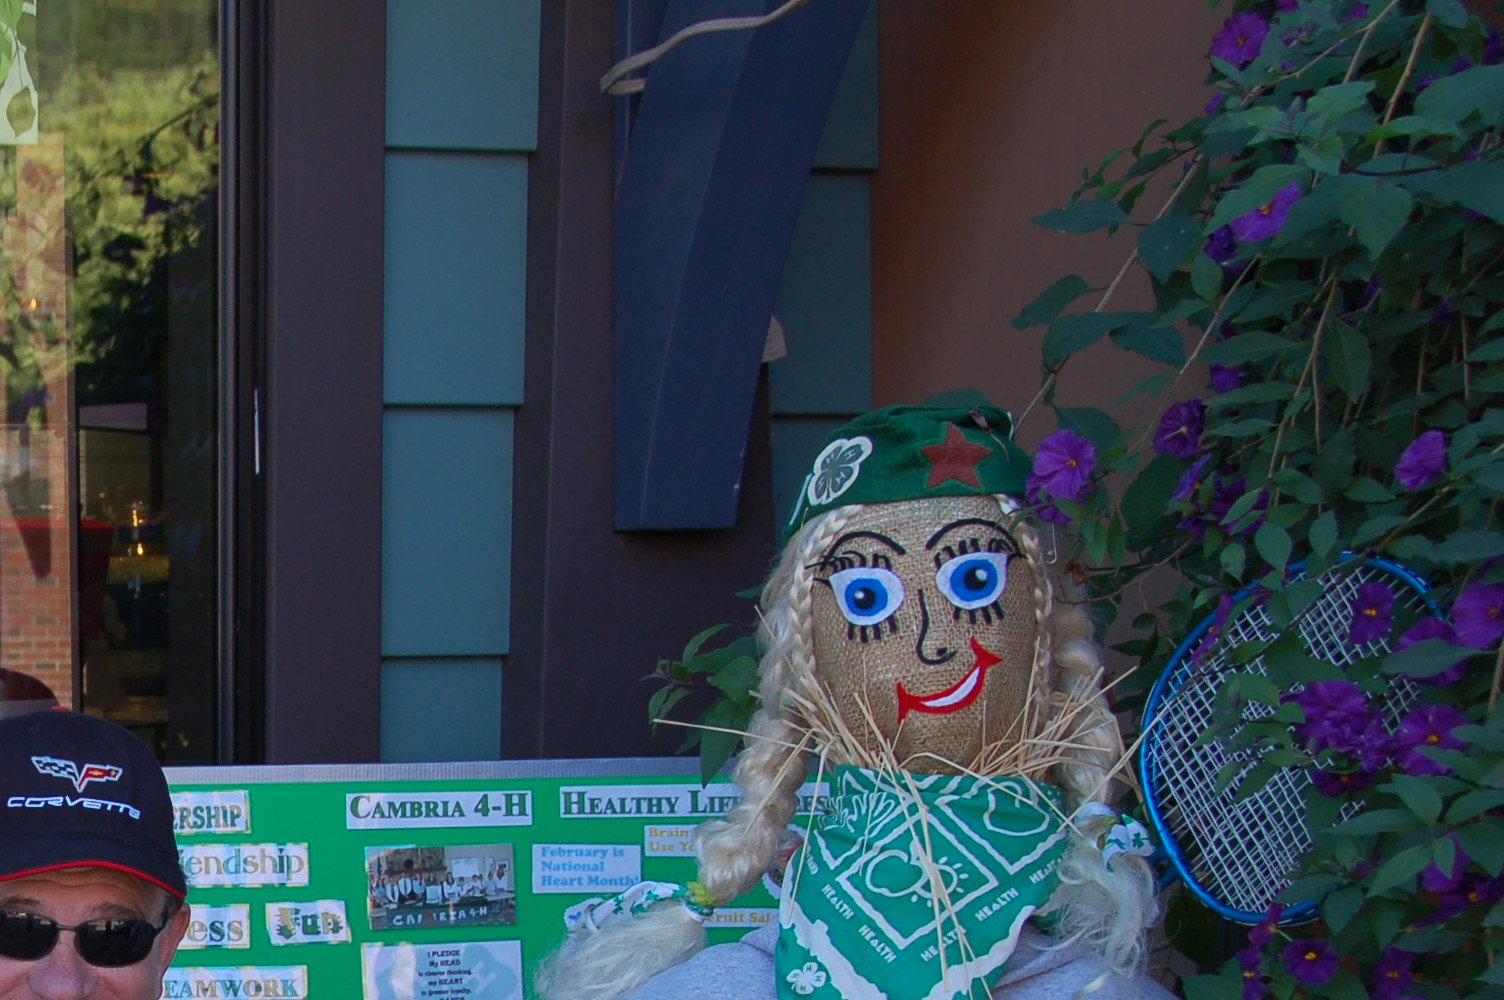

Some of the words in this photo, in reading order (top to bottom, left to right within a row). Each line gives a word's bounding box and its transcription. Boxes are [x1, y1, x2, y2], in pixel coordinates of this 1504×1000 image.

[7, 796, 141, 820] CORVETTE
[173, 804, 242, 829] RSHIP
[474, 793, 529, 818] 4-H
[649, 827, 689, 838] Brain
[541, 846, 607, 860] February
[613, 846, 625, 858] is
[649, 841, 675, 852] Use
[179, 848, 304, 881] iendship
[541, 861, 605, 872] National
[541, 875, 583, 886] Heart
[821, 884, 854, 920] HEALTH
[974, 887, 1019, 922] HEALTH
[858, 924, 897, 964] HEALTH
[163, 979, 299, 998] EAMWORK
